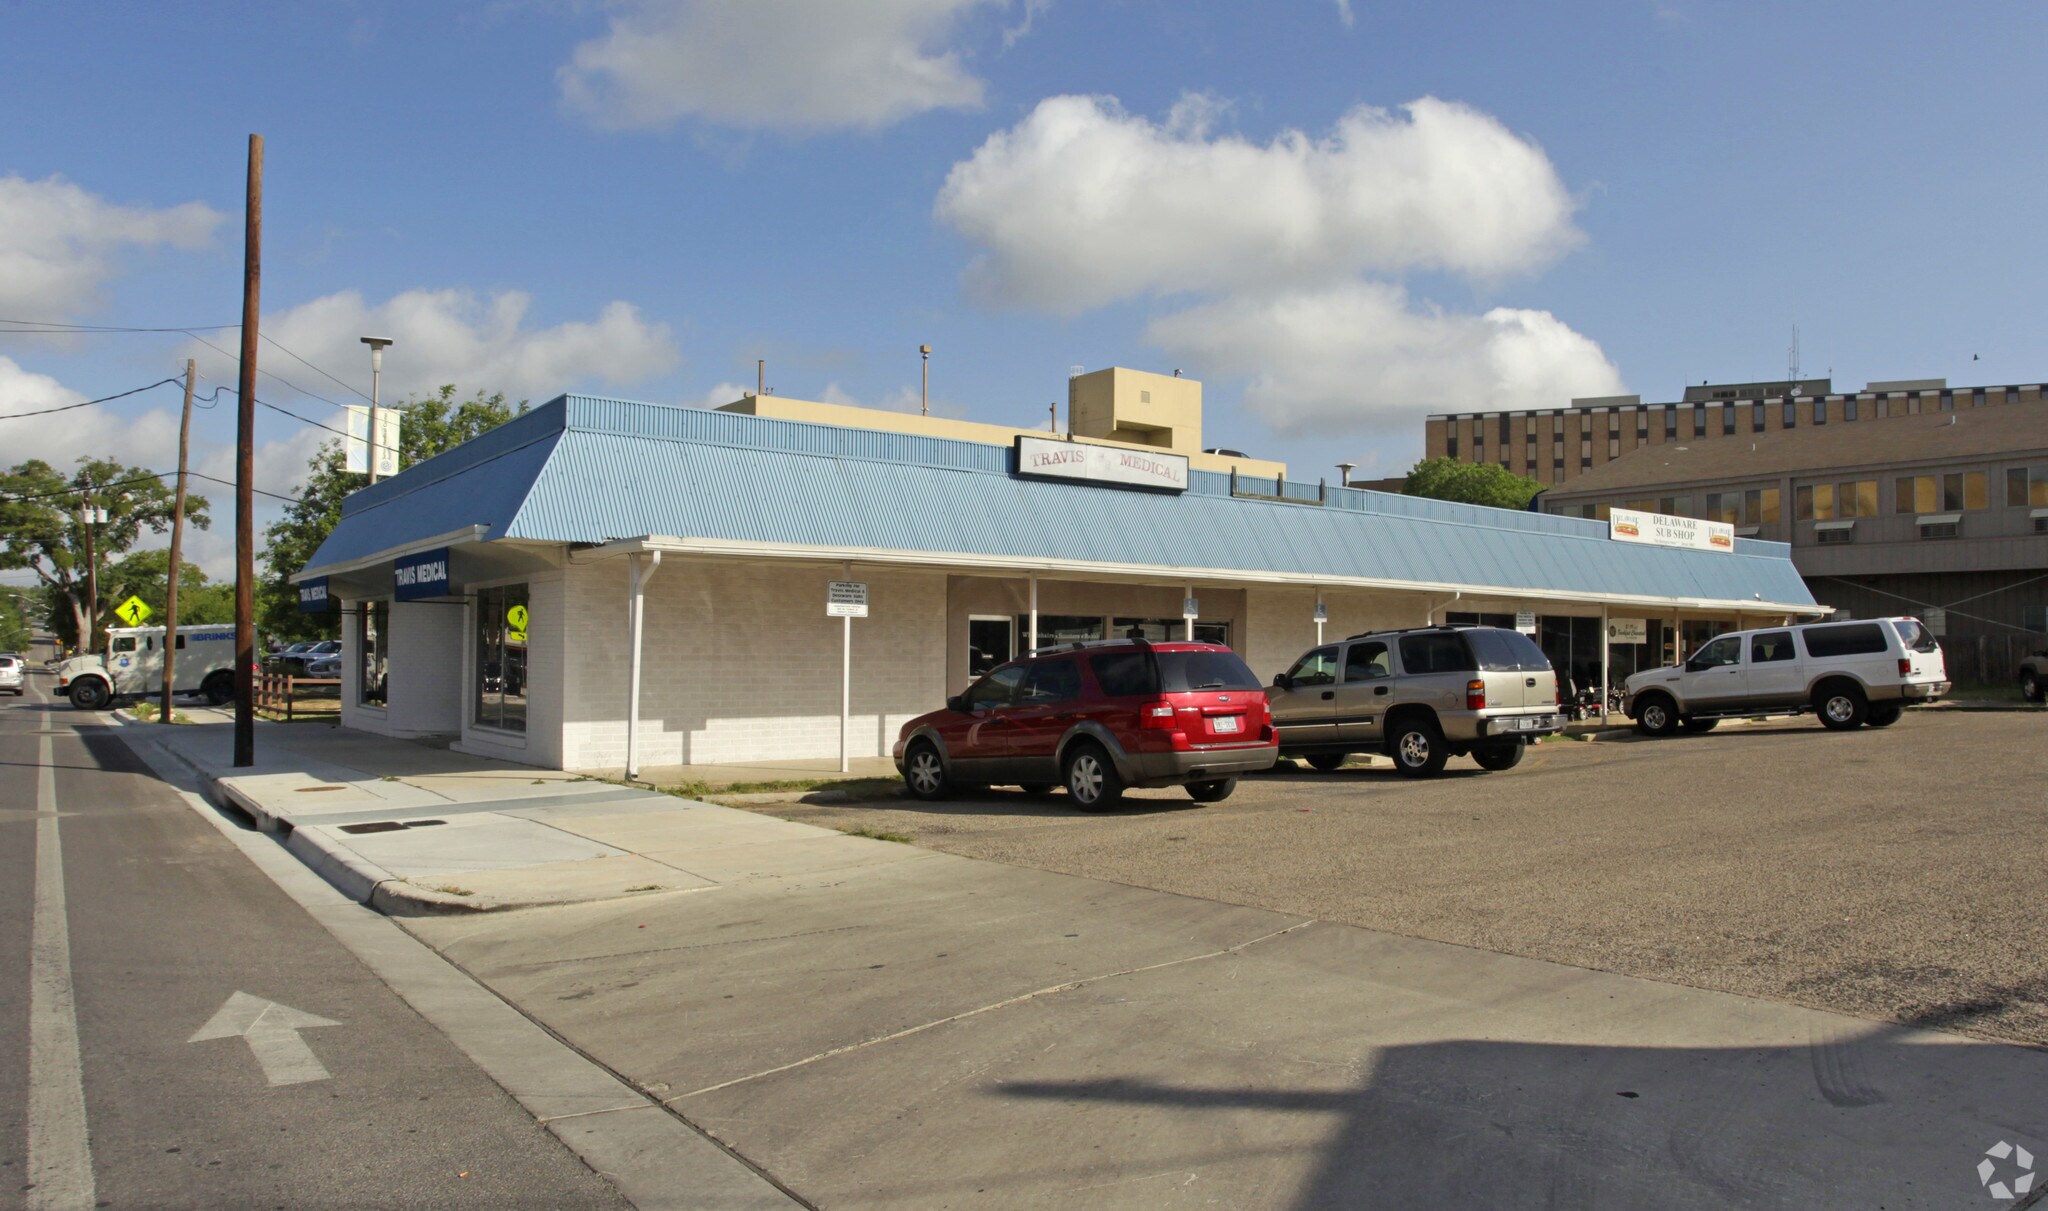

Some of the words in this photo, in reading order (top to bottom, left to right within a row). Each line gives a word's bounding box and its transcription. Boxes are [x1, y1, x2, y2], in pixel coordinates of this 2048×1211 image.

[1030, 450, 1085, 467] TRAVIS
[1119, 453, 1181, 482] MEDICAL
[1653, 514, 1698, 530] DELAWARE
[1655, 526, 1672, 538] SUB
[1673, 529, 1695, 541] SHOP
[395, 565, 416, 586] TRAVIS
[416, 561, 447, 583] MEDICAL
